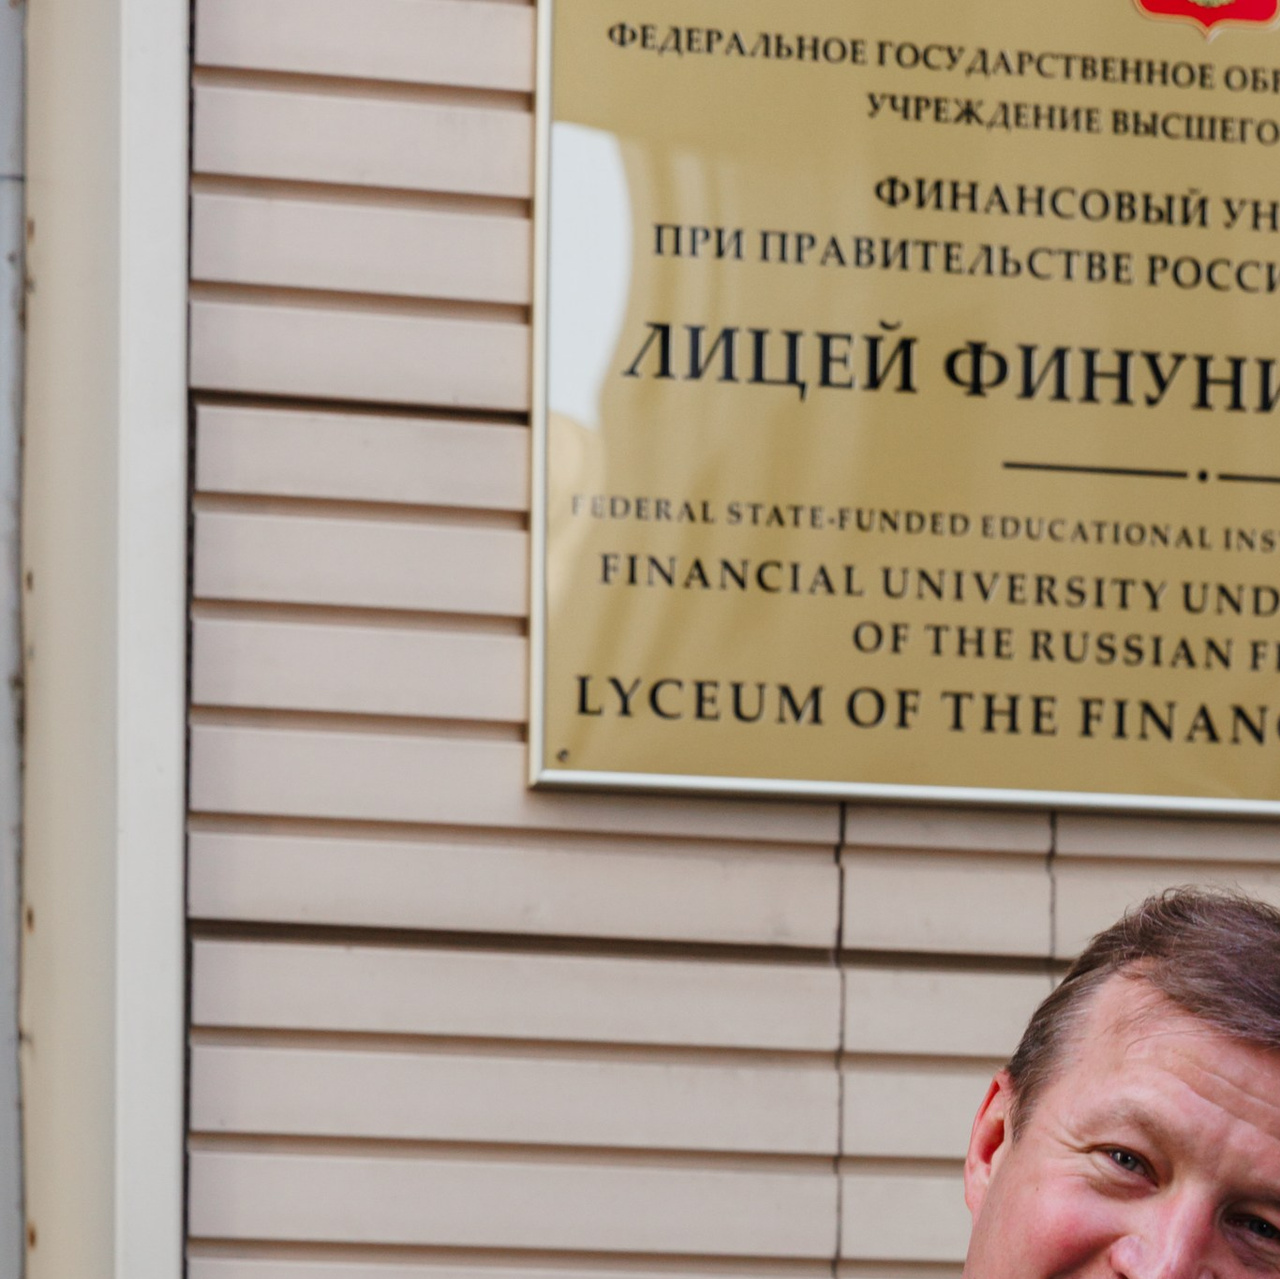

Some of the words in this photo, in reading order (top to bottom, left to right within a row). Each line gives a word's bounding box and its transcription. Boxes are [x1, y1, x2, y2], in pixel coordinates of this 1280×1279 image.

[606, 22, 867, 65] ФЕДЕРАЛЬНОЕ
[876, 41, 1215, 90] ГОСУДАРСТВЕННОЕ
[866, 92, 1101, 134] УЧРЕЖДЕНИЕ
[873, 176, 1210, 229] ФИНАНСОВЫЙ
[654, 223, 745, 260] ПРИ
[759, 231, 1133, 285] ПРАВИТЕЛЬСТВЕ
[623, 321, 919, 401] ЛИЦЕЙ
[569, 493, 719, 527] FEDERAL
[726, 503, 972, 537] STATE-FUNDED
[980, 515, 1213, 551] EDUCATIONAL
[601, 554, 864, 597] FINANCIAL
[881, 567, 1168, 612] UNIVERSITY
[852, 622, 910, 655] OF
[925, 625, 1014, 660] THE
[1030, 630, 1233, 670] RUSSIAN
[576, 675, 824, 726] LYCEUM
[845, 687, 922, 730] OF
[941, 691, 1058, 736] THE
